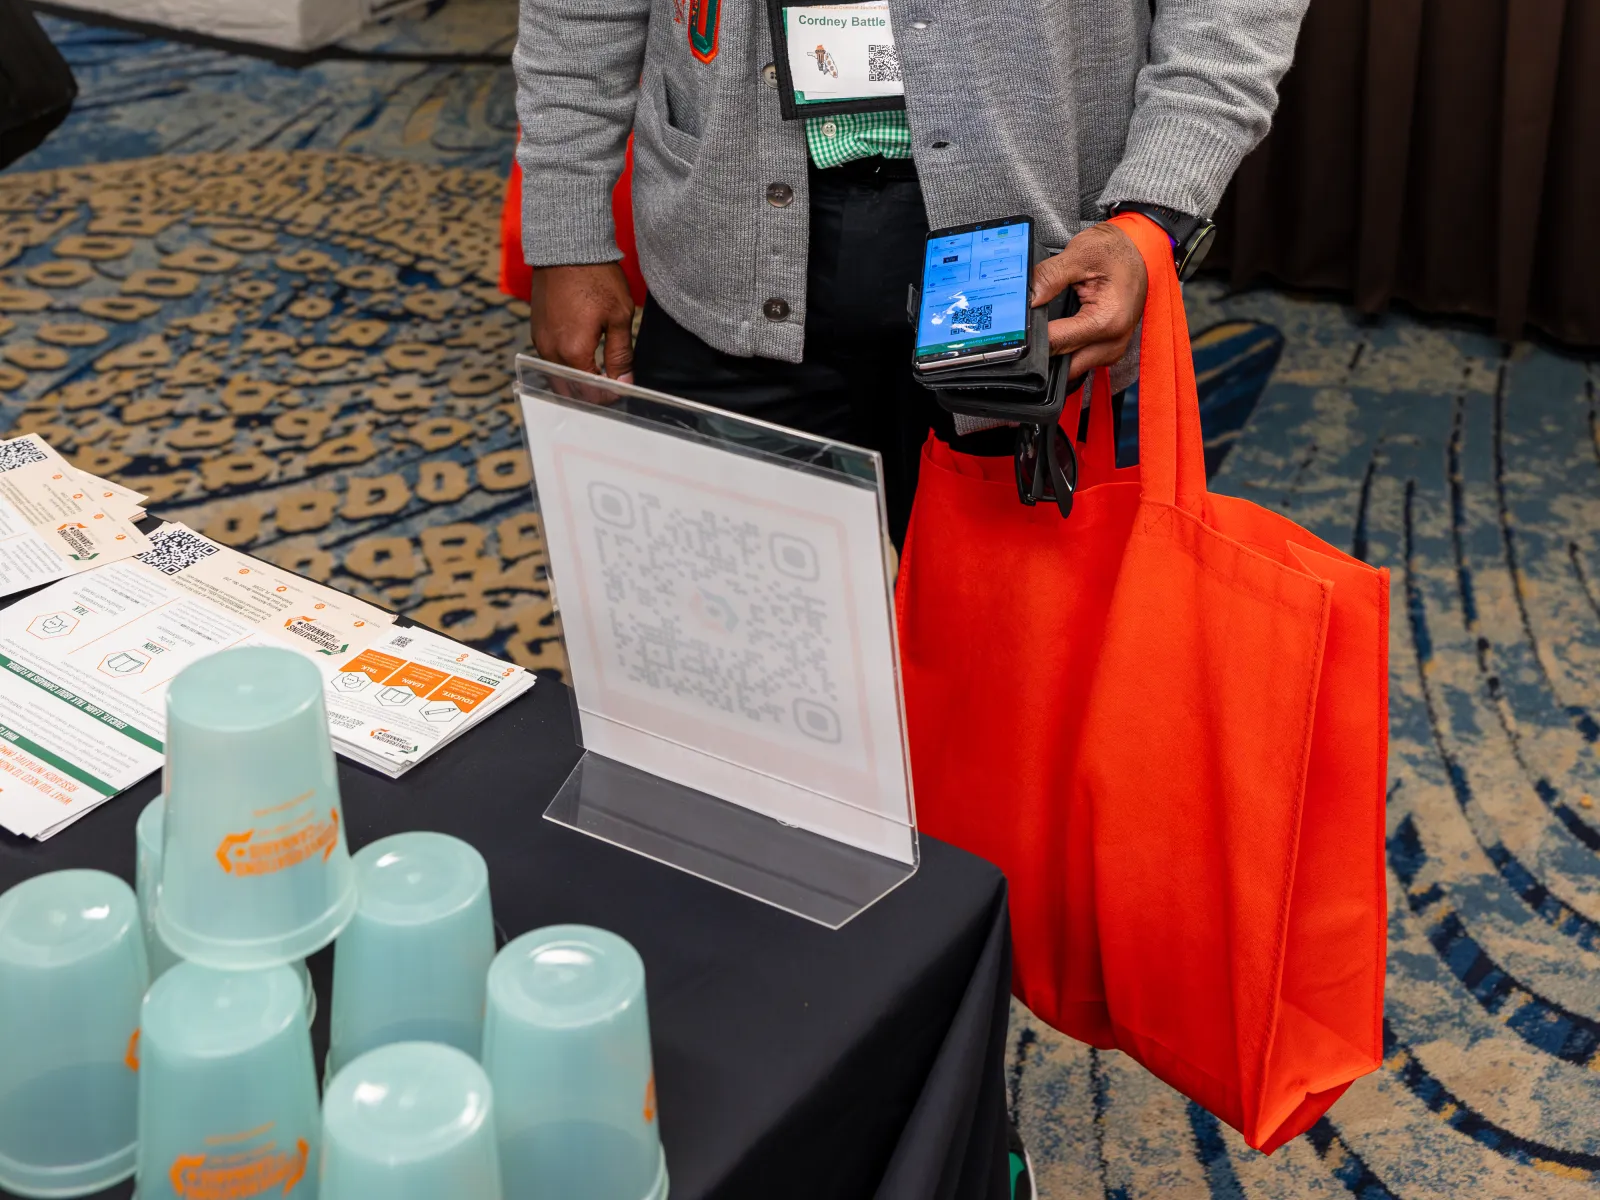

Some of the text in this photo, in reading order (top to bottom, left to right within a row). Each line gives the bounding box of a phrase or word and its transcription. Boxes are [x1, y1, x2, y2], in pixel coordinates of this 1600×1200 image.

[798, 14, 886, 28] Cordney Battle
[72, 605, 89, 616] TALK
[287, 625, 339, 651] CONVERSATIONS
[300, 623, 335, 640] CANNABIS
[142, 642, 164, 654] LEARN
[360, 665, 378, 674] TALK.
[32, 674, 58, 692] CANNABIS
[401, 678, 426, 688] LEARN.
[54, 686, 73, 700] ABOUT
[442, 691, 474, 705] EDUCATE.
[73, 696, 88, 707] TALK
[373, 735, 412, 750] CONVERSATIONS
[382, 733, 407, 743] CANNABIS
[13, 755, 46, 774] INITIATIVE
[12, 768, 24, 777] TO
[21, 774, 39, 786] NEED
[42, 772, 79, 792] RESEARCH
[37, 783, 54, 794] YOU
[50, 792, 72, 805] WHAT
